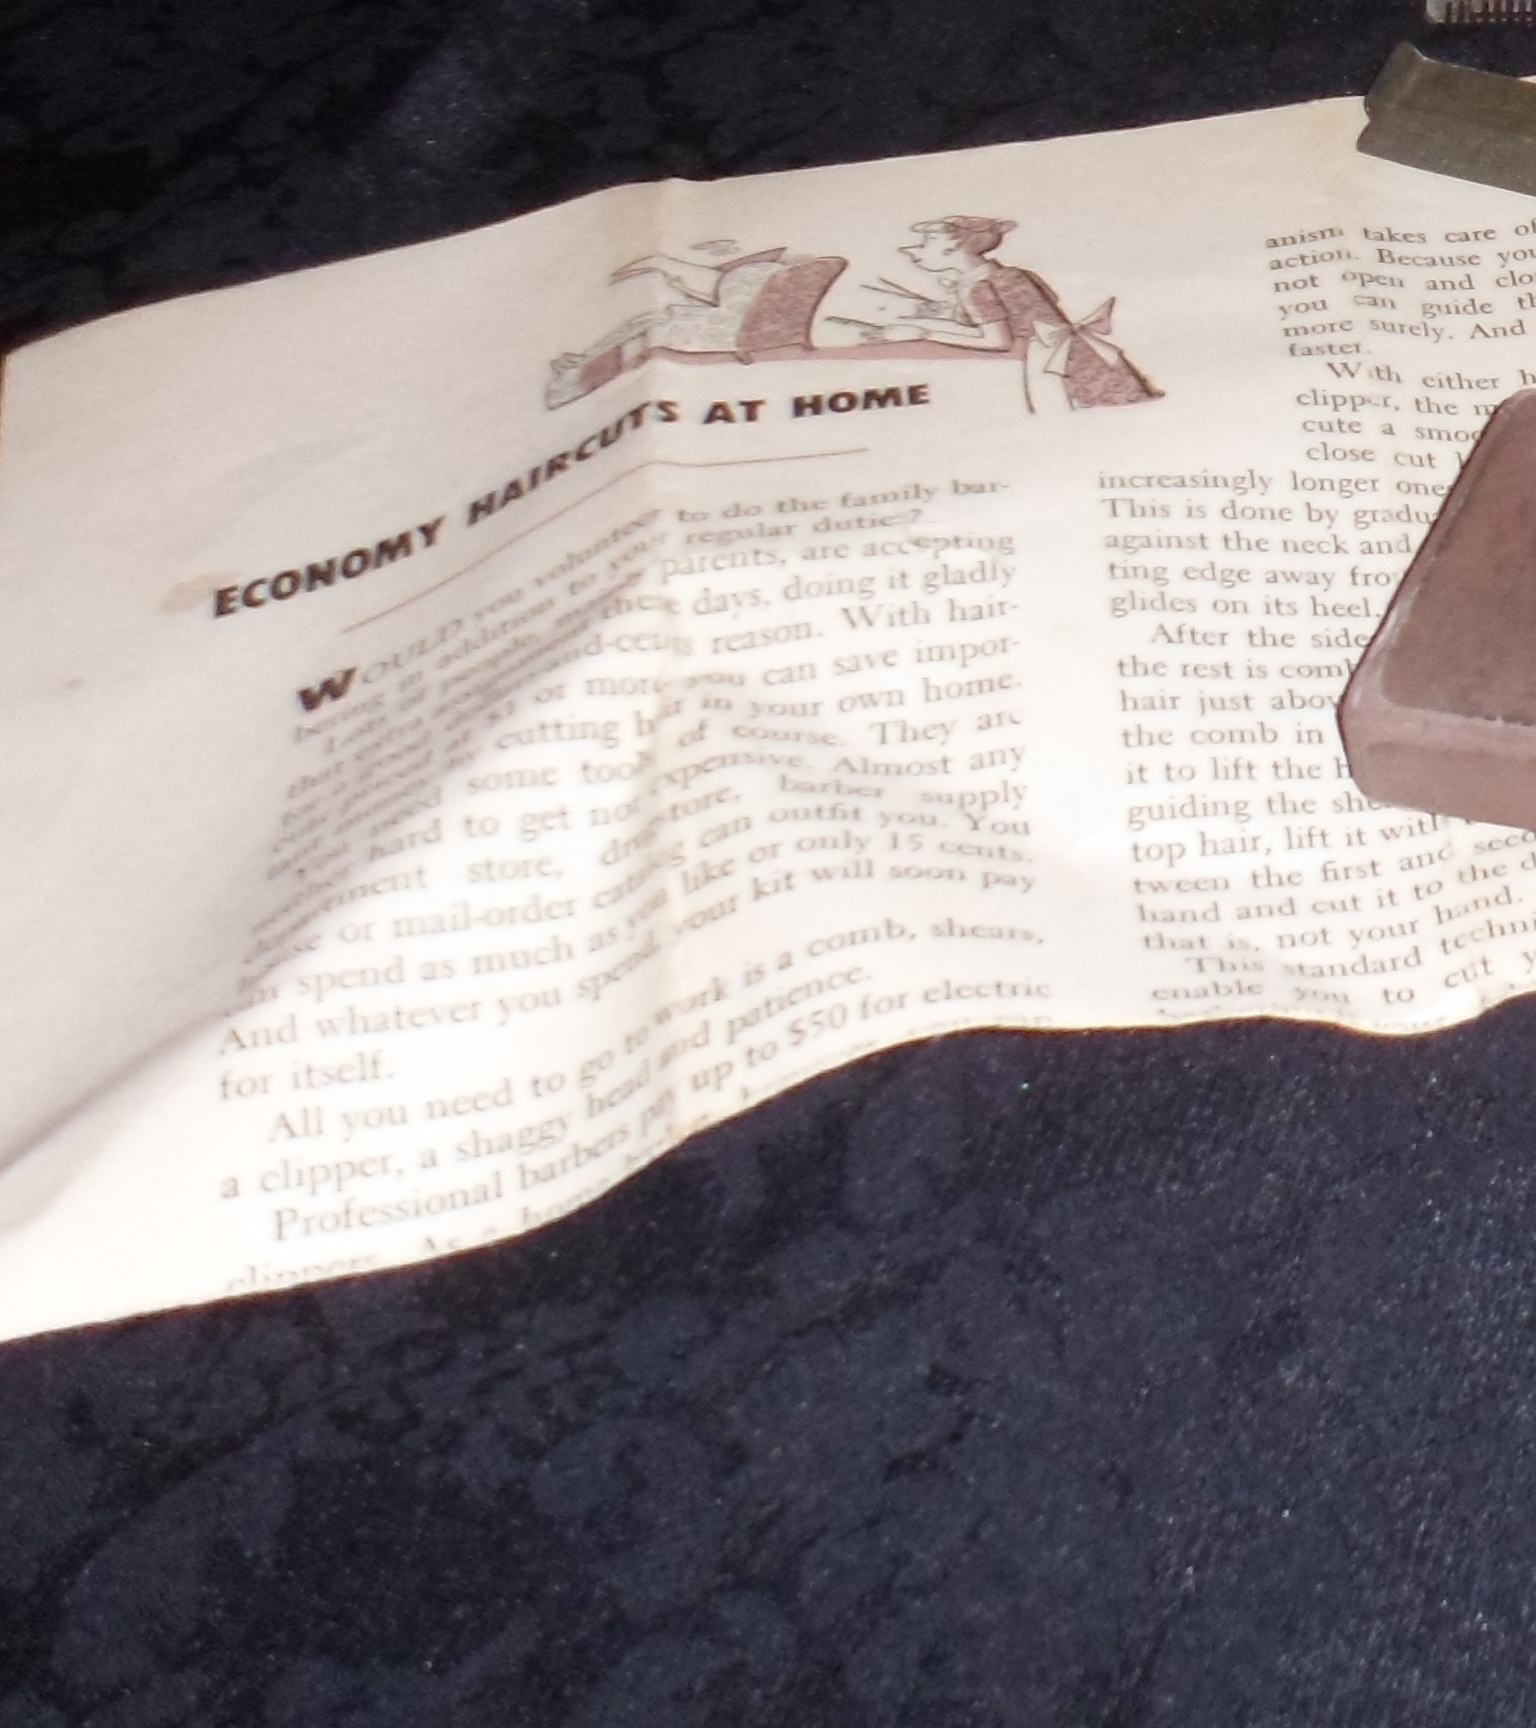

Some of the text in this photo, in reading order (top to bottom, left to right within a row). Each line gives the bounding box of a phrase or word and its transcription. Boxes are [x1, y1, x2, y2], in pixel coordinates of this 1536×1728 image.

[1362, 225, 1427, 245] takes
[1444, 224, 1497, 245] care
[1377, 248, 1481, 268] Because
[1273, 274, 1320, 294] not
[1425, 274, 1475, 292] and
[1278, 297, 1329, 322] you
[1353, 294, 1397, 310] can
[1420, 296, 1494, 320] guide
[1282, 318, 1354, 339] more
[1369, 318, 1454, 344] surely.
[1469, 319, 1527, 341] And
[1421, 371, 1500, 391] either
[1414, 396, 1460, 417] the
[1301, 416, 1362, 437] cute
[1381, 420, 1397, 437] a
[1305, 443, 1437, 470] close cut
[839, 483, 937, 510] family
[1098, 469, 1380, 498] increasingly longer
[212, 383, 931, 619] ECONOMY HAIRCUTS AT HOME
[1101, 498, 1339, 527] This is done by
[802, 541, 849, 562] are
[1104, 532, 1411, 558] against the neck and
[783, 560, 1017, 601] doing it gladly
[1108, 561, 1336, 591] ting edge away
[841, 601, 932, 631] With
[1111, 592, 1382, 619] glides on its heel.
[1150, 624, 1295, 648] After the
[762, 647, 899, 687] can save
[1117, 656, 1268, 679] the rest is
[838, 673, 1023, 714] own home.
[1120, 690, 1255, 716] hair just
[870, 719, 957, 746] They
[1122, 722, 1324, 748] the comb in
[832, 745, 1026, 778] Almost any
[1127, 757, 1322, 785] it to lift the
[1127, 790, 1317, 831] guiding the
[1131, 825, 1367, 869] top hair, lift it
[1251, 859, 1381, 889] the first
[1137, 860, 1509, 924] hand and cut it to the
[393, 894, 577, 939] mail-order
[1277, 885, 1525, 950] not your hand.
[1382, 987, 1416, 1005] to
[274, 979, 1052, 1242] Professional electric
[426, 1077, 514, 1122] need
[457, 1111, 572, 1158] shaggy
